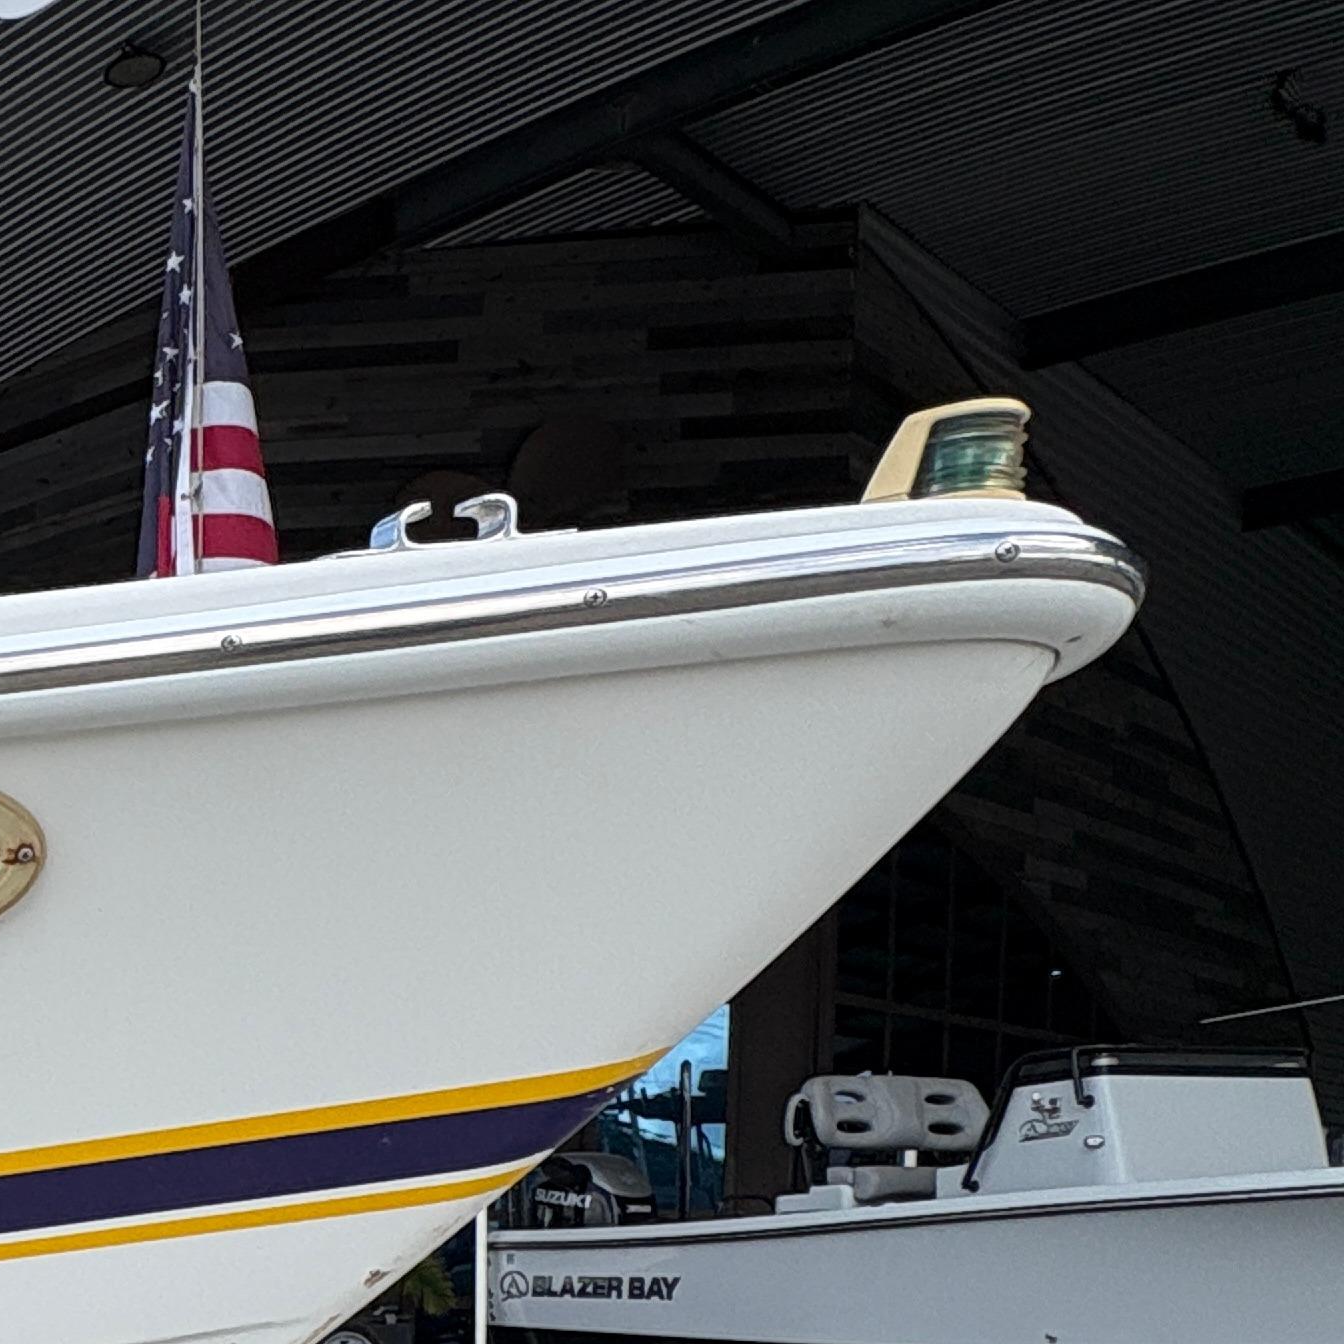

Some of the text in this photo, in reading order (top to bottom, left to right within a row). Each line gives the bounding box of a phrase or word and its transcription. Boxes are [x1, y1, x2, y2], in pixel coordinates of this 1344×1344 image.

[534, 1188, 592, 1208] SUZUKI
[531, 1275, 681, 1301] BLAZER BAY
